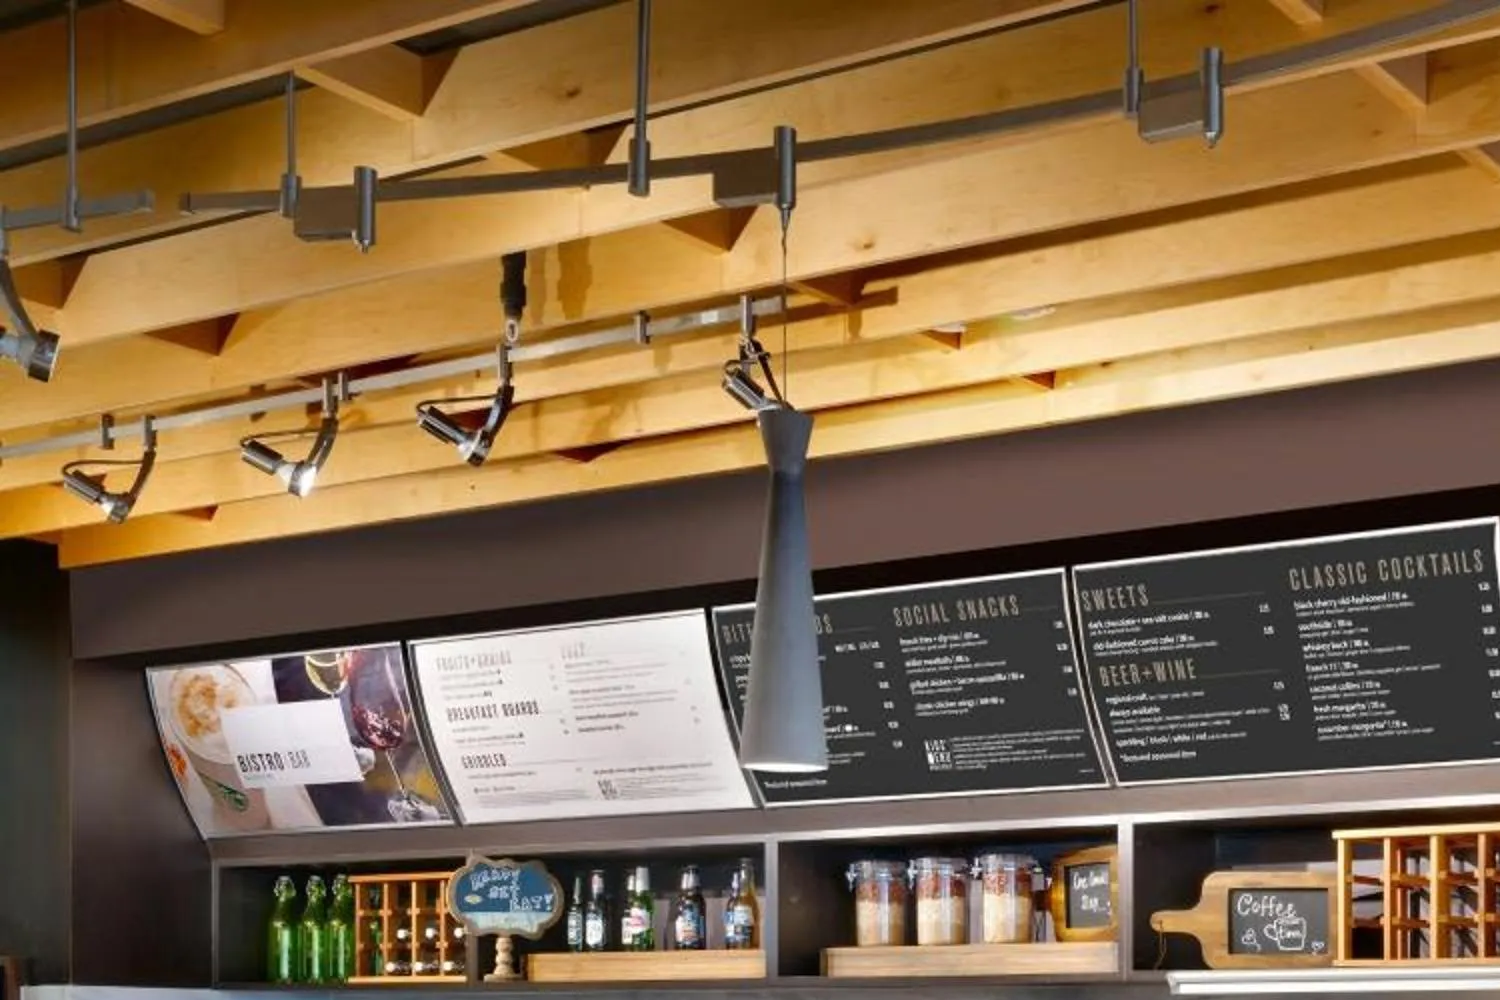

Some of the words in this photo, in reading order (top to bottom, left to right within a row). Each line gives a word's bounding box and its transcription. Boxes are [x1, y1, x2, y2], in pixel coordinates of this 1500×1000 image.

[1289, 561, 1368, 591] CLASSIC
[1377, 548, 1484, 581] COCKTAILS
[893, 602, 950, 627] SOCIAL
[956, 594, 1020, 621] SNACKS
[1081, 583, 1149, 612] SWEETS
[1099, 658, 1197, 687] BEER+WINE
[237, 752, 284, 773] BISTRO
[1237, 893, 1297, 917] Coffee
